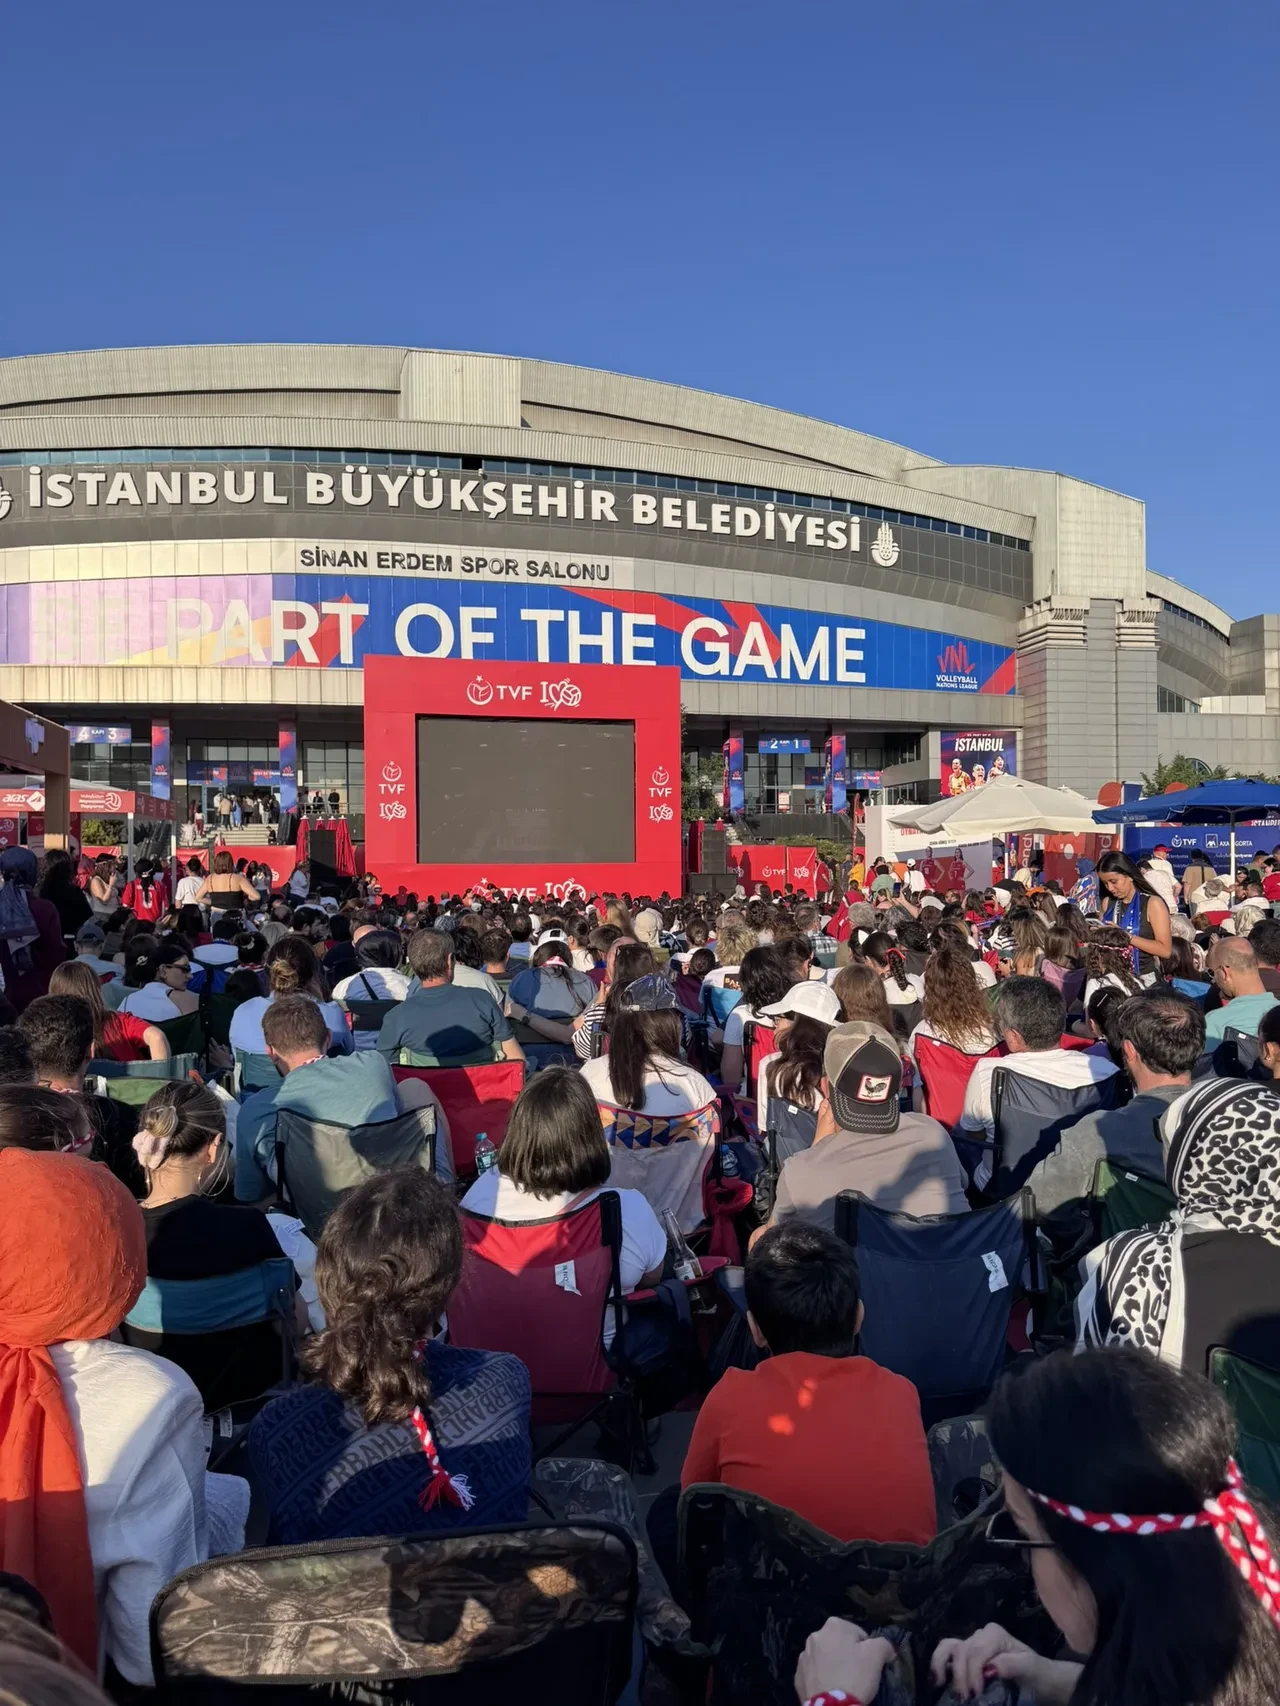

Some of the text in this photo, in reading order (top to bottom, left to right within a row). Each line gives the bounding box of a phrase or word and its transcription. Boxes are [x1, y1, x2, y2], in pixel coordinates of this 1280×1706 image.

[28, 464, 862, 553] İSTANBUL BÜYÜKŞEHİR BELEDİYESİ
[300, 545, 611, 581] SİNAN ERDEM SPOR SALONU
[167, 598, 370, 665] PART
[394, 601, 497, 659] OF
[520, 607, 657, 666] THE
[680, 616, 867, 684] GAME
[936, 674, 978, 684] VOLLEYBALL
[496, 685, 533, 700] TVF
[107, 727, 117, 740] 3
[770, 738, 778, 749] 2
[793, 739, 799, 749] 1
[379, 783, 405, 795] TVF
[648, 787, 672, 797] TVF
[1183, 838, 1197, 846] TVF
